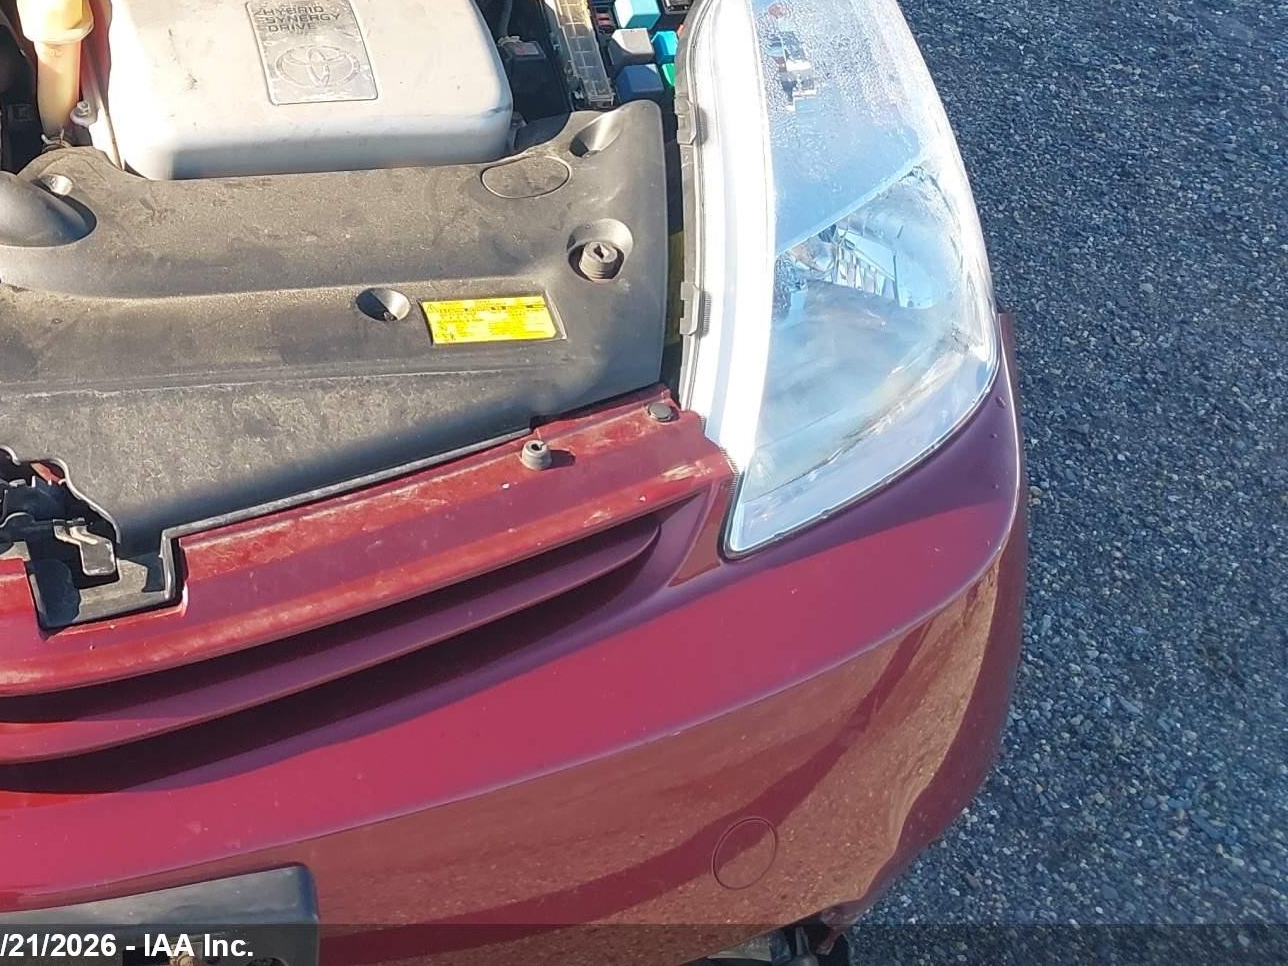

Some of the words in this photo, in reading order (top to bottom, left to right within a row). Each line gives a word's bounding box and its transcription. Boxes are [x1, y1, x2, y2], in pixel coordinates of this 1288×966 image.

[263, 5, 324, 16] HYBRID
[265, 13, 340, 24] SYNERGY
[268, 22, 317, 33] DRIVE
